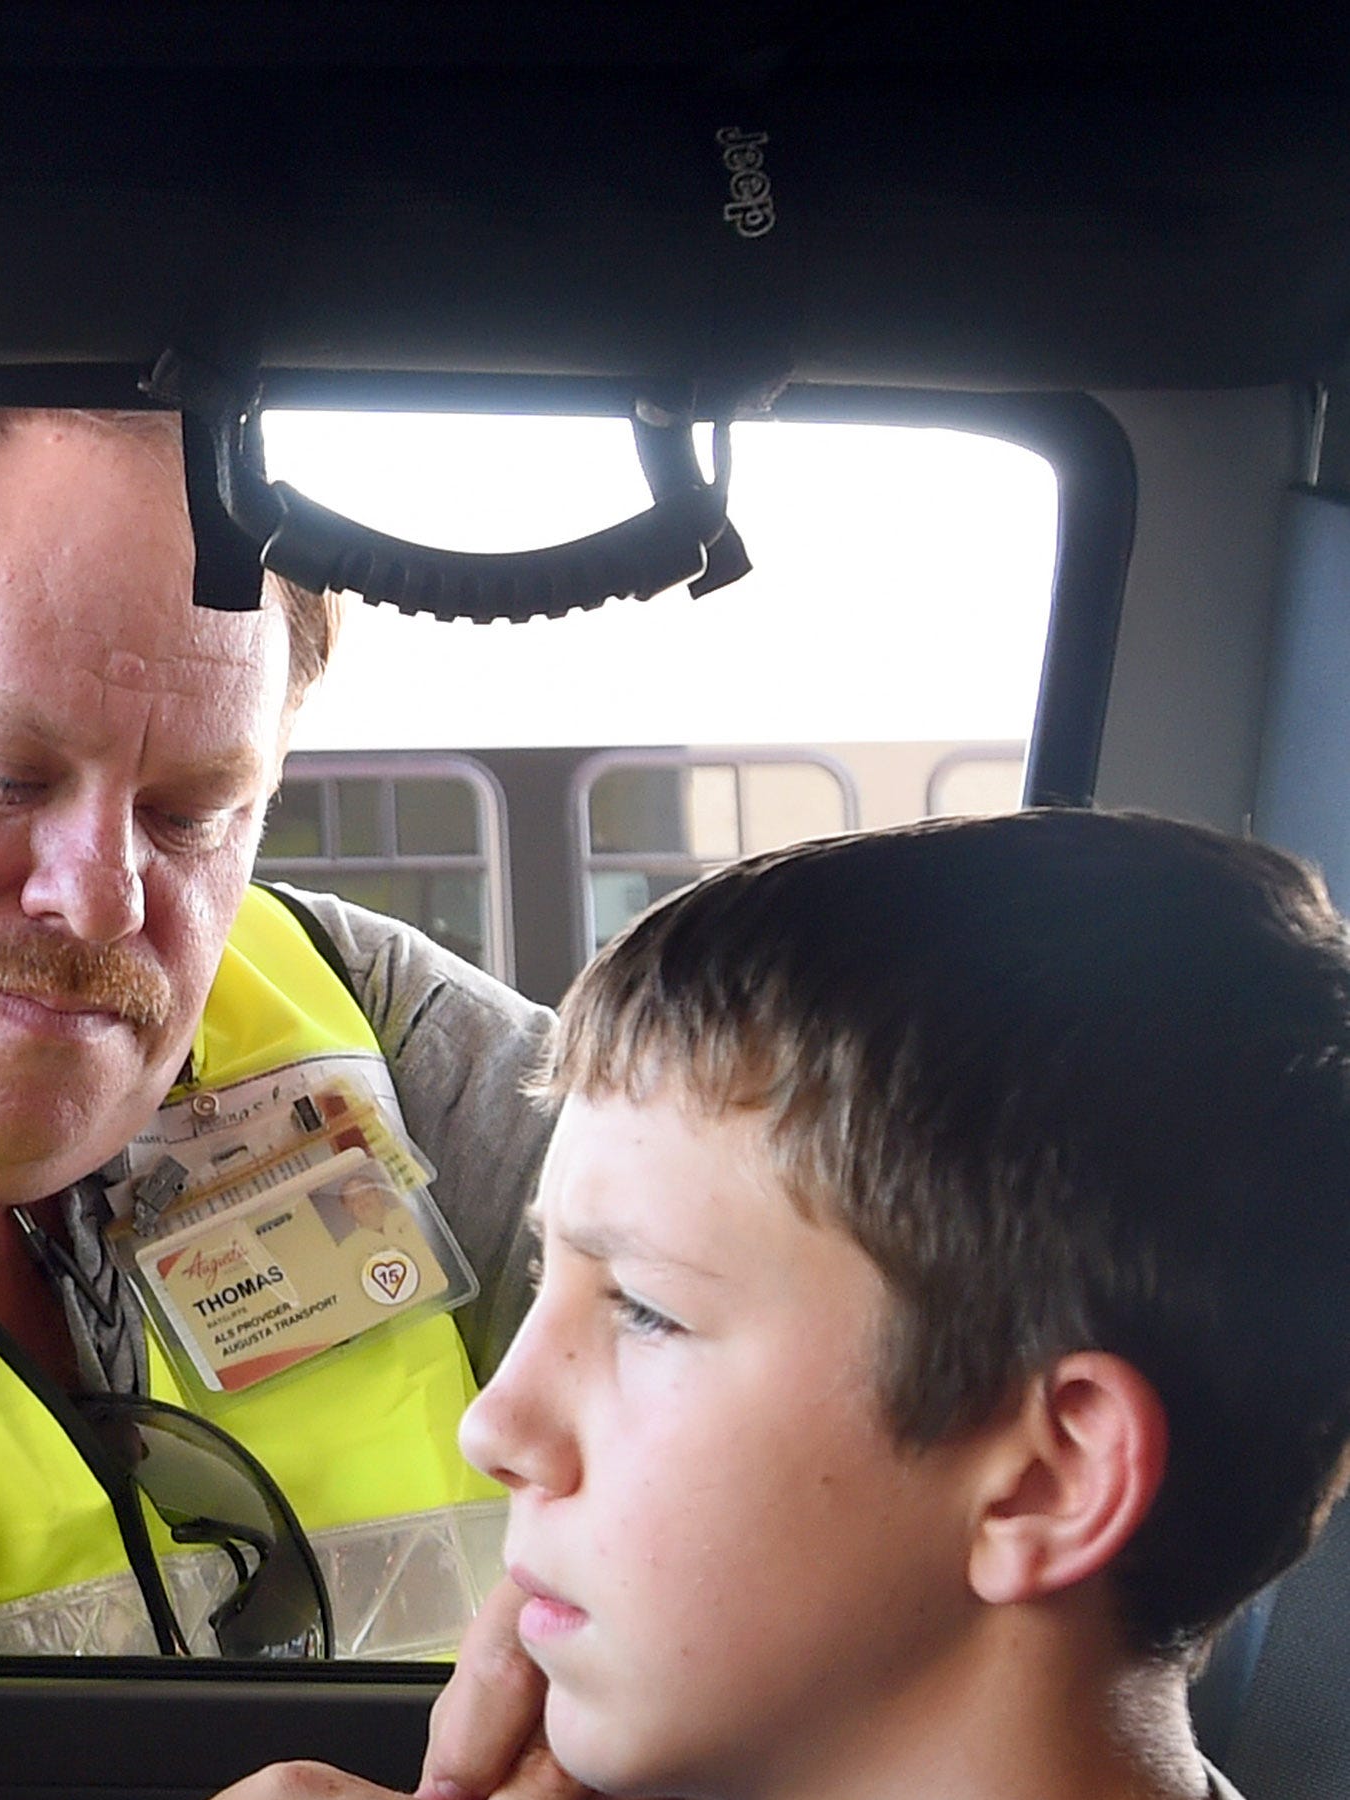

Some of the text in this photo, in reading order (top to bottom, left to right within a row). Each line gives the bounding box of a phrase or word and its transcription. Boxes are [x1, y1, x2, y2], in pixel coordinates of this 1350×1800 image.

[715, 126, 776, 237] Jeep
[193, 1265, 284, 1317] THOMAS
[379, 1269, 399, 1285] 15
[214, 1302, 293, 1345] ALS PROVIDER
[222, 1294, 339, 1358] AUGUSTA TRANSPORT
